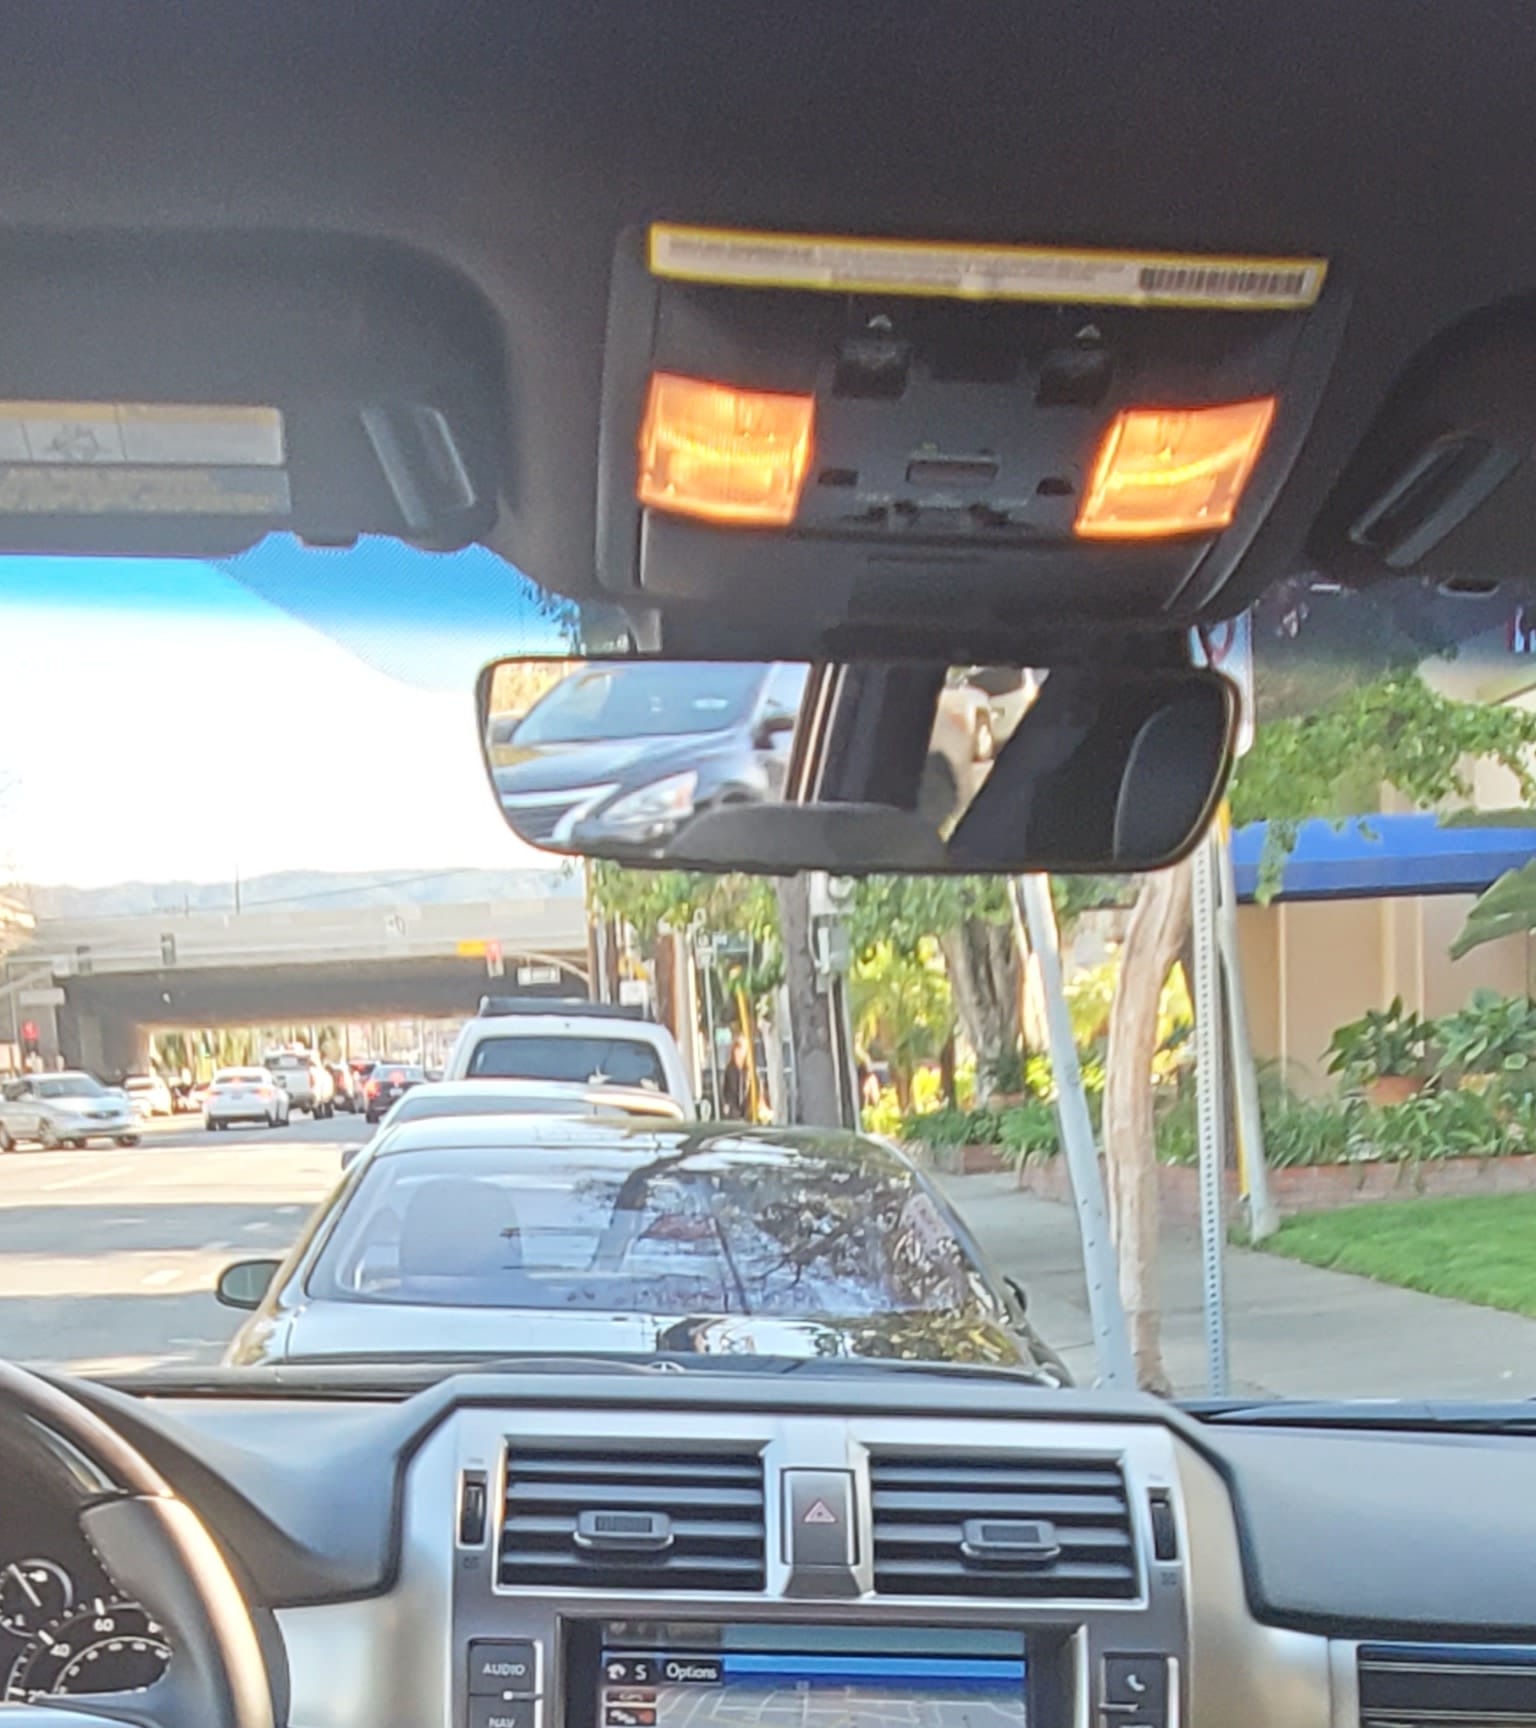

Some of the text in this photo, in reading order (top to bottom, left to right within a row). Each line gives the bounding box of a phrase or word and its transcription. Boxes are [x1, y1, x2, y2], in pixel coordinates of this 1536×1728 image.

[94, 1618, 115, 1632] 60
[482, 1663, 527, 1677] AUDIO
[635, 1664, 647, 1681] S
[666, 1662, 718, 1681] Options
[488, 1716, 516, 1728] NAV
